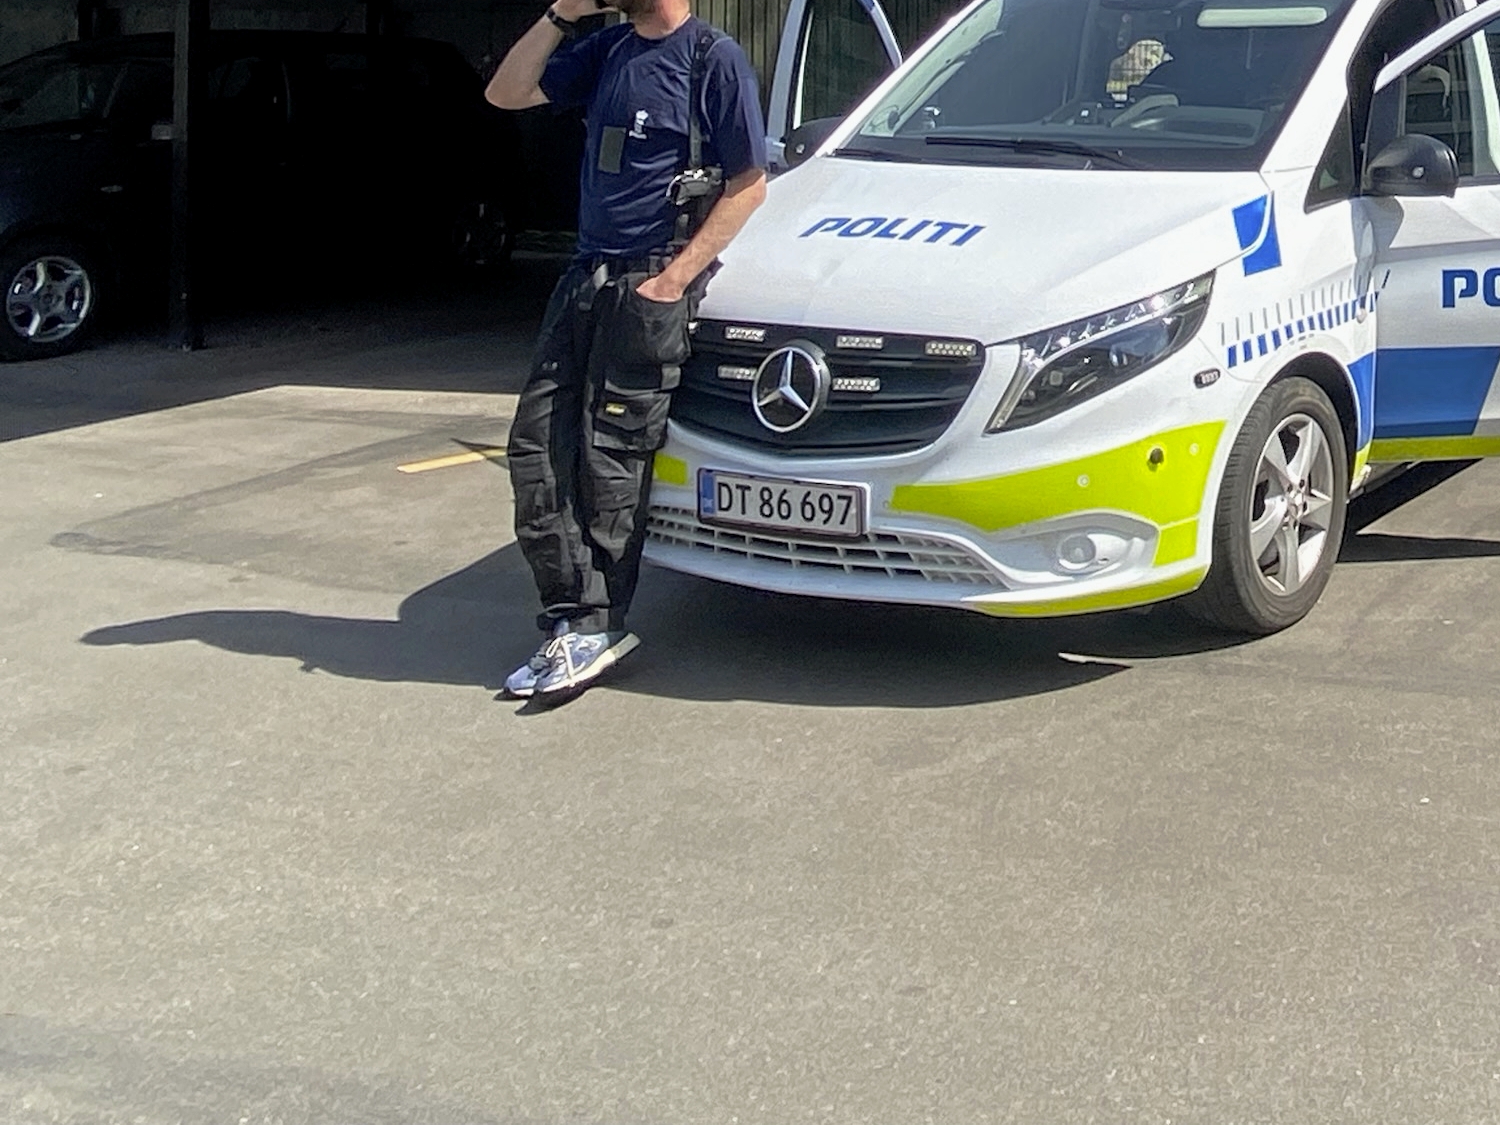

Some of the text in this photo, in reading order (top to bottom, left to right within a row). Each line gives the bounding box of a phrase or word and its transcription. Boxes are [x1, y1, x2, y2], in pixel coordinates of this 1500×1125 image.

[798, 217, 986, 246] POLITI
[717, 482, 853, 525] DT 86 697
